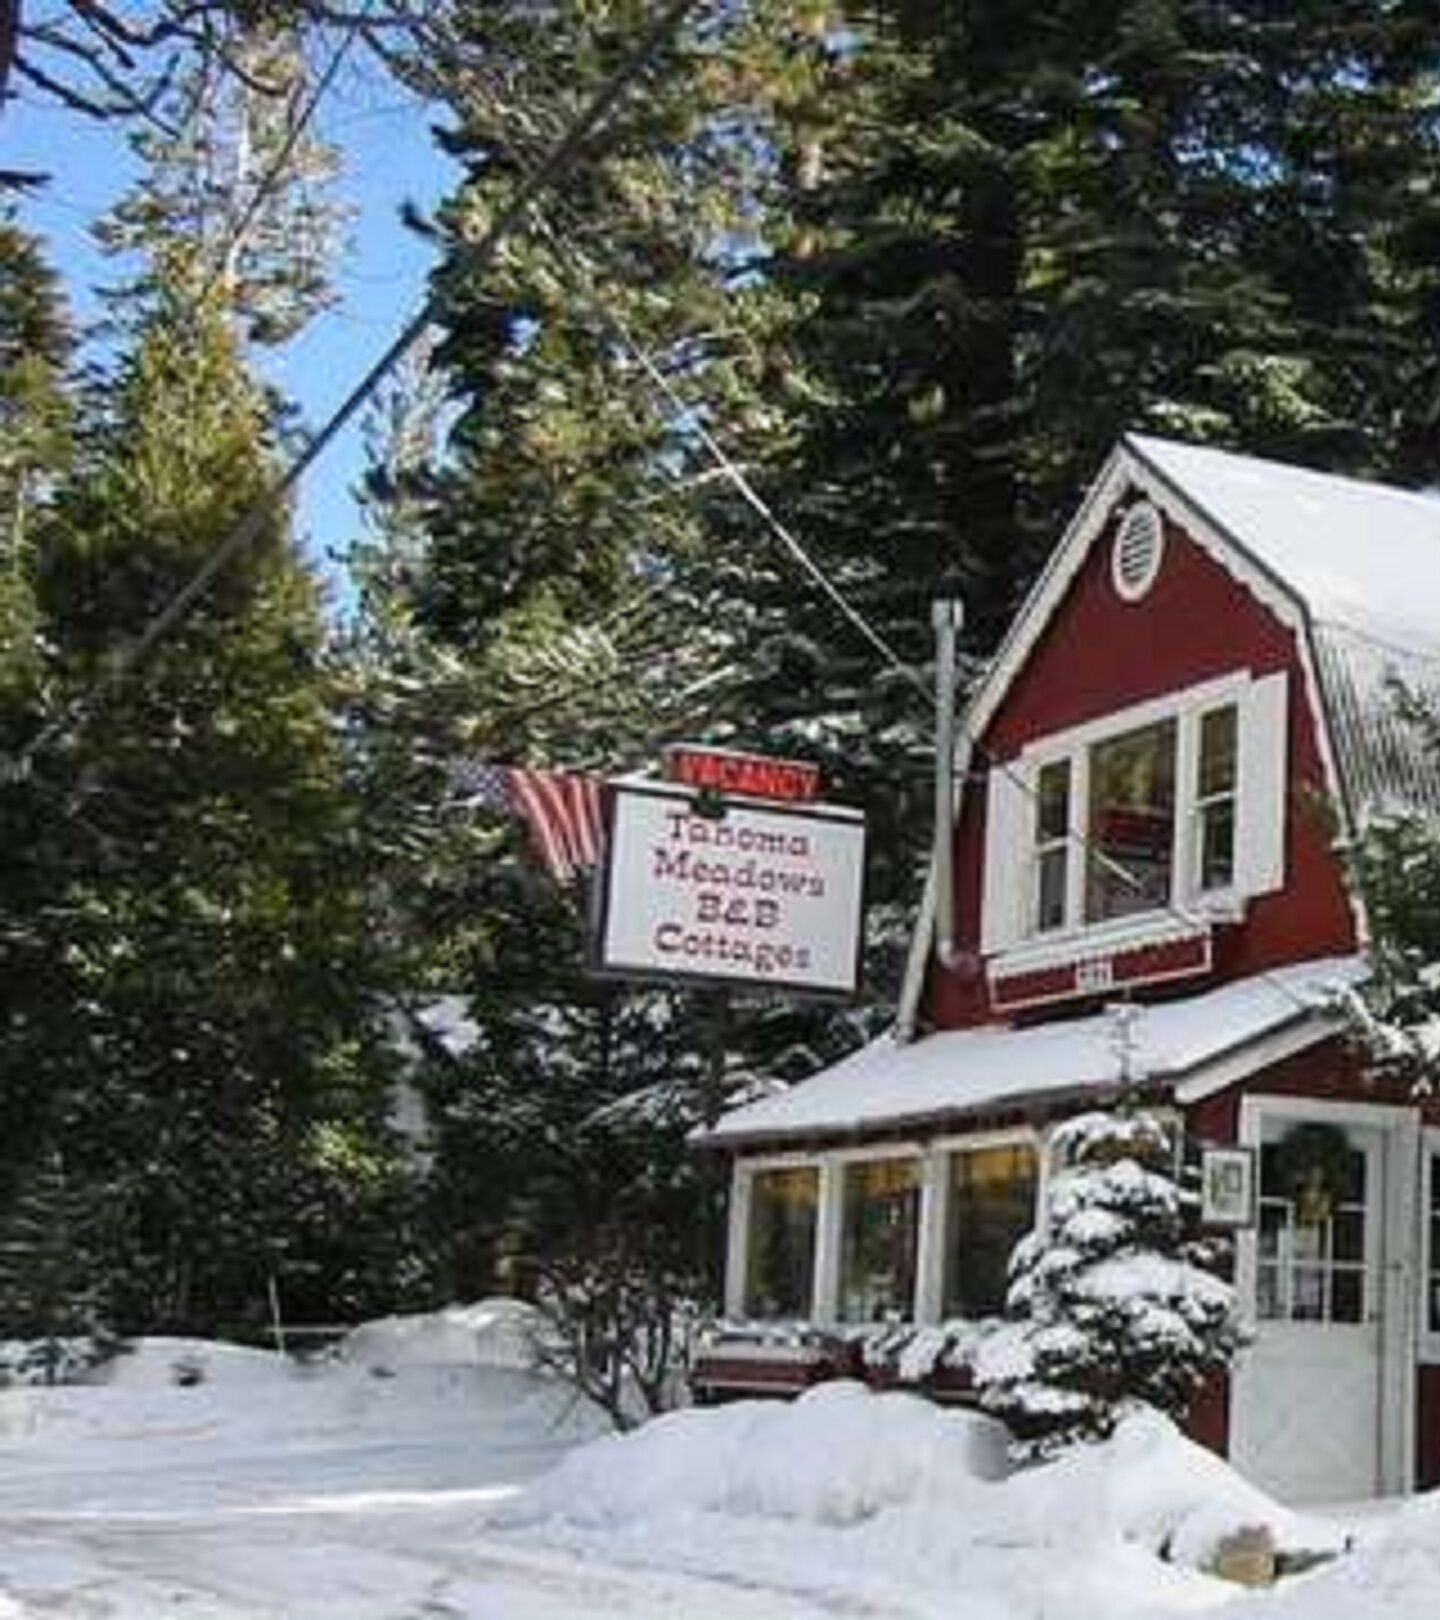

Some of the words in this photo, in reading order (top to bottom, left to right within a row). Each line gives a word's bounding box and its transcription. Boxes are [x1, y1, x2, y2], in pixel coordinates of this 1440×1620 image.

[678, 752, 819, 799] VACANCY
[654, 849, 826, 897] Meadows
[697, 891, 780, 928] B&B
[656, 922, 811, 972] Cottages
